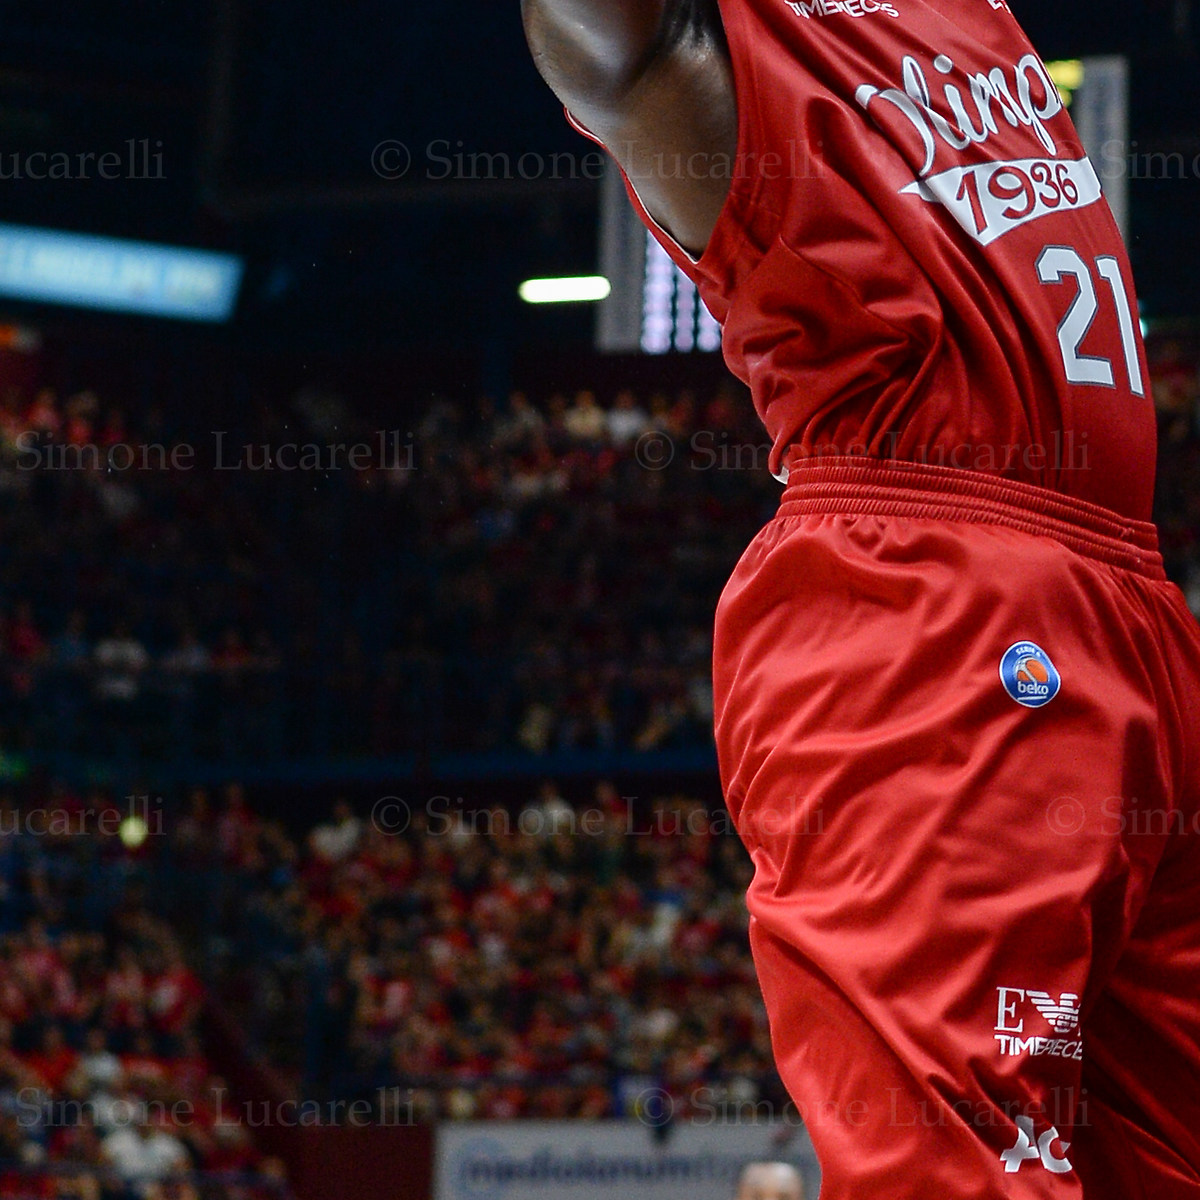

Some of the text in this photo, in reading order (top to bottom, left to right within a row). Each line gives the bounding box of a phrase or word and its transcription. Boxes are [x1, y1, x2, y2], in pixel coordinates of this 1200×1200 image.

[956, 162, 1078, 235] 1936
[1035, 245, 1145, 399] 21
[1018, 681, 1049, 695] beko
